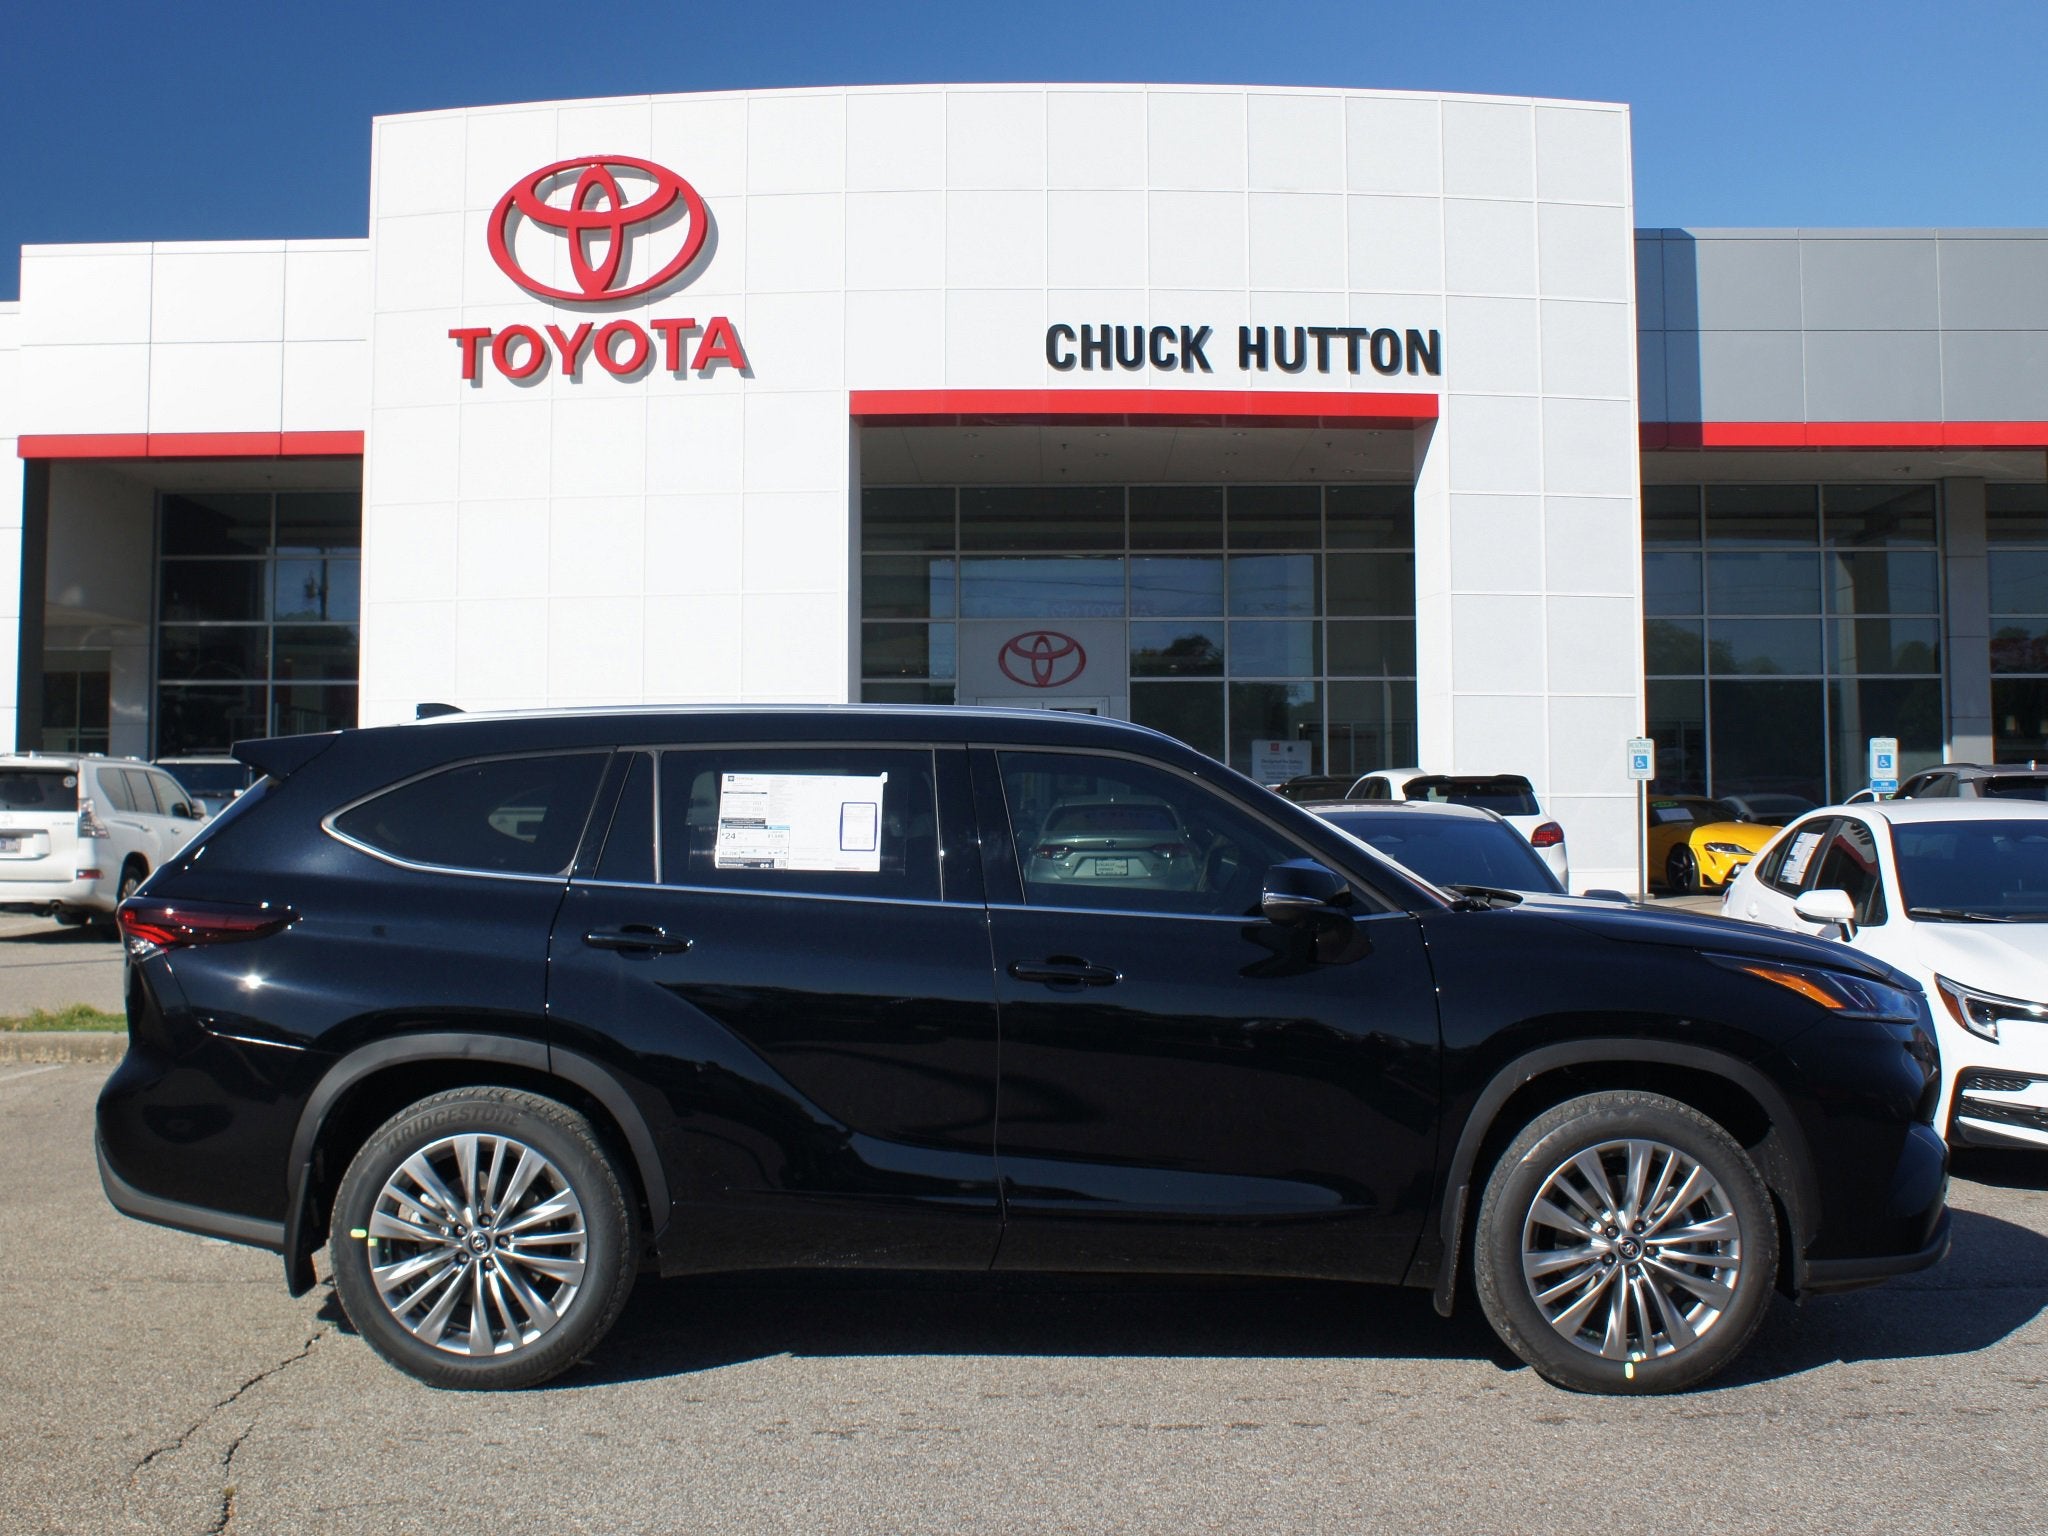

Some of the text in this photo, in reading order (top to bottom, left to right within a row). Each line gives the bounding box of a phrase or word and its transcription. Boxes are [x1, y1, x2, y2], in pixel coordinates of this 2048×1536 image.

[448, 316, 748, 380] TOYOTA
[1046, 323, 1441, 376] CHUCK HUTTON
[387, 1105, 520, 1152] BRIDGESTONE
